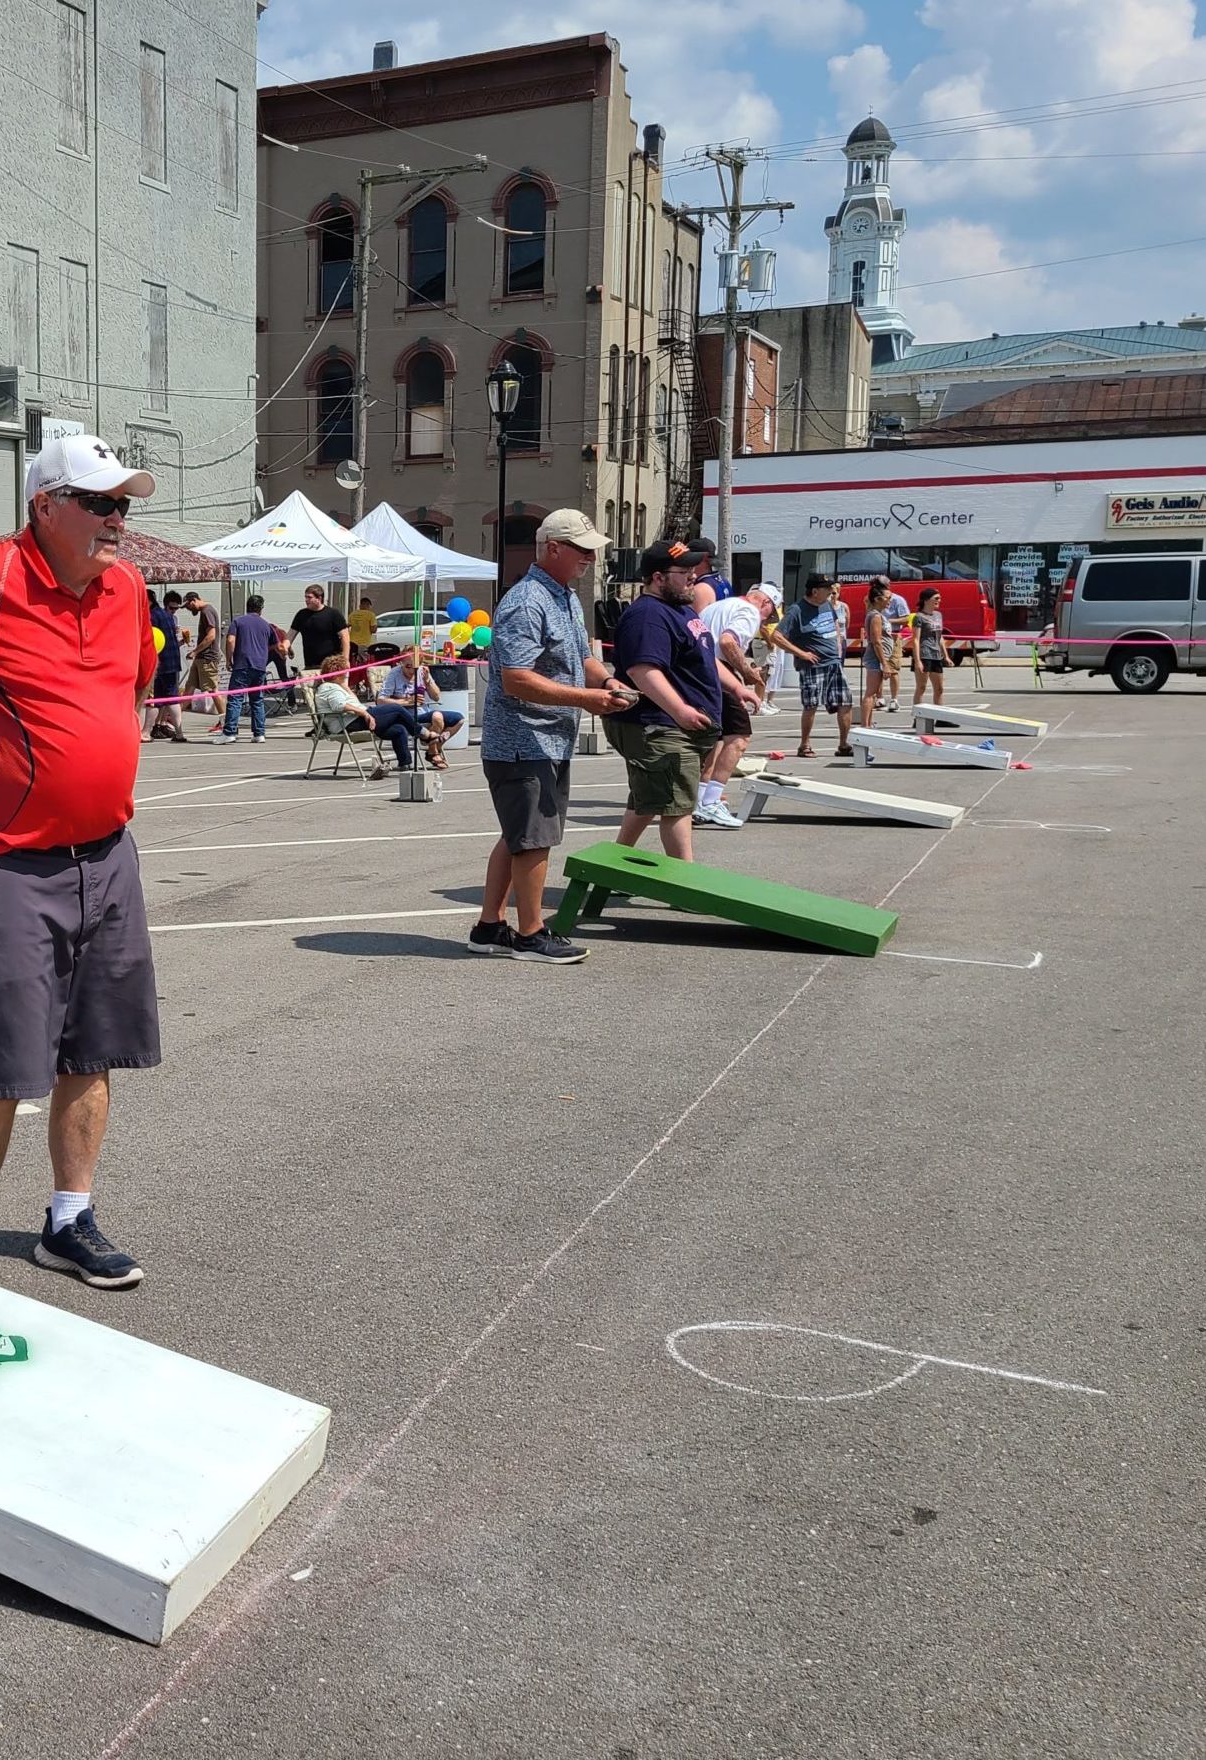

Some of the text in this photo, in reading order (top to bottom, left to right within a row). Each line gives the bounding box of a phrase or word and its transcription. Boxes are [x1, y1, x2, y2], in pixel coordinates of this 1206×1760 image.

[1125, 494, 1206, 510] Geis Audio/
[809, 512, 975, 531] Pregnancy Center
[250, 539, 323, 551] CHURCH
[1008, 553, 1042, 561] provide
[230, 562, 289, 573] mchurch.org
[1002, 560, 1044, 568] Computer
